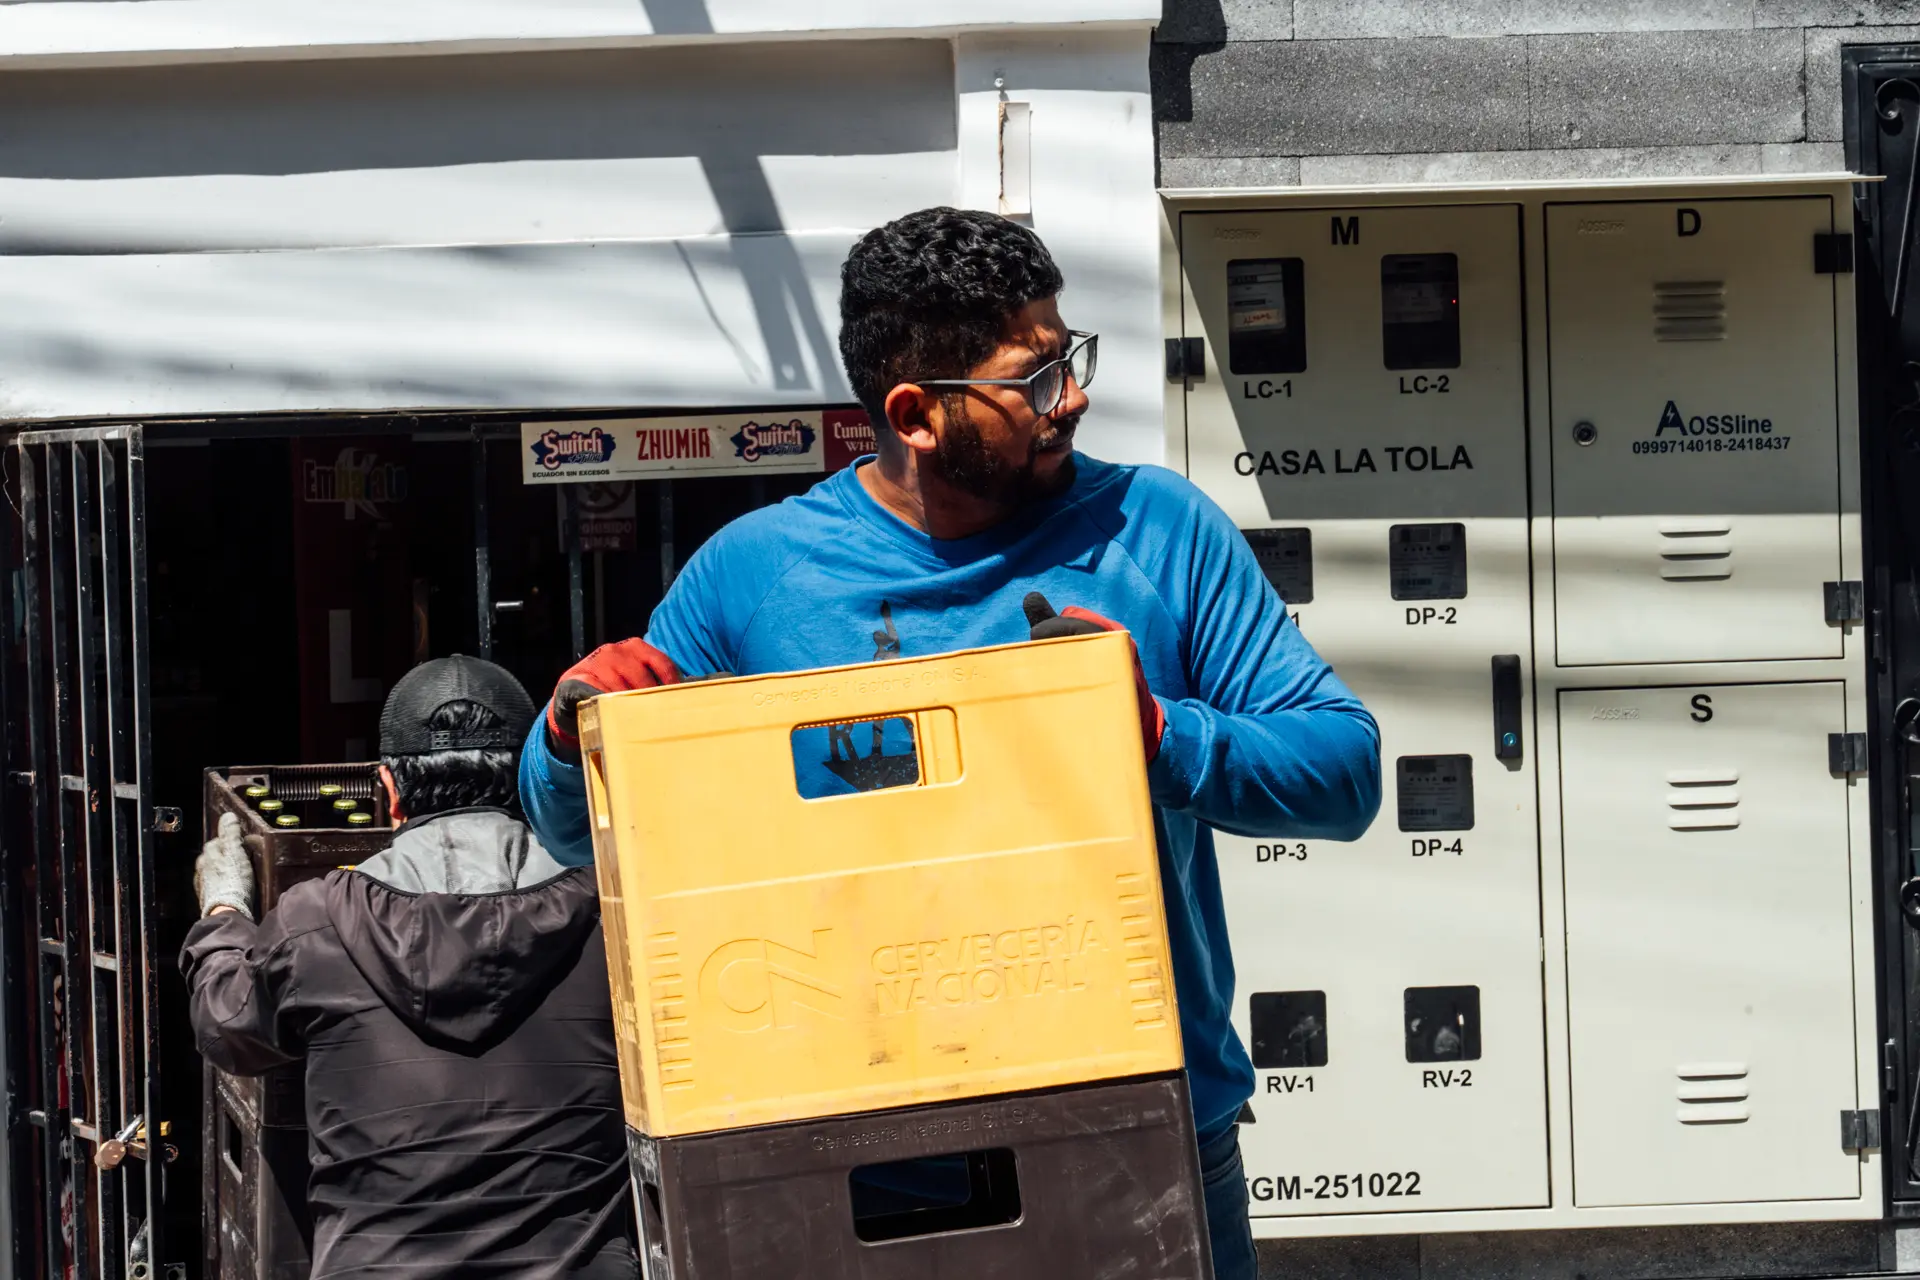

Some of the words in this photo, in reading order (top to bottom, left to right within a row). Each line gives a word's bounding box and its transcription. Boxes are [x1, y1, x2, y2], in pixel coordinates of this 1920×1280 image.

[1331, 216, 1360, 245] M
[1677, 208, 1701, 237] D
[1244, 380, 1293, 400] LC-1
[1400, 375, 1450, 395] LC-2
[541, 427, 604, 470] Switch
[742, 419, 803, 462] Switch
[1632, 436, 1791, 454] 0999714018-2418437
[1234, 449, 1326, 477] CASA
[1334, 448, 1377, 474] LA
[1385, 445, 1474, 472] TOLA
[1405, 607, 1457, 625] DP-2
[1690, 694, 1713, 723] S
[1256, 844, 1307, 863] DP-3
[1411, 838, 1464, 857] DP-4
[875, 957, 1088, 1017] NACIONAL
[1267, 1075, 1315, 1094] RV-1
[1422, 1069, 1472, 1088] RV-2
[1246, 1171, 1421, 1202] GM-251022
